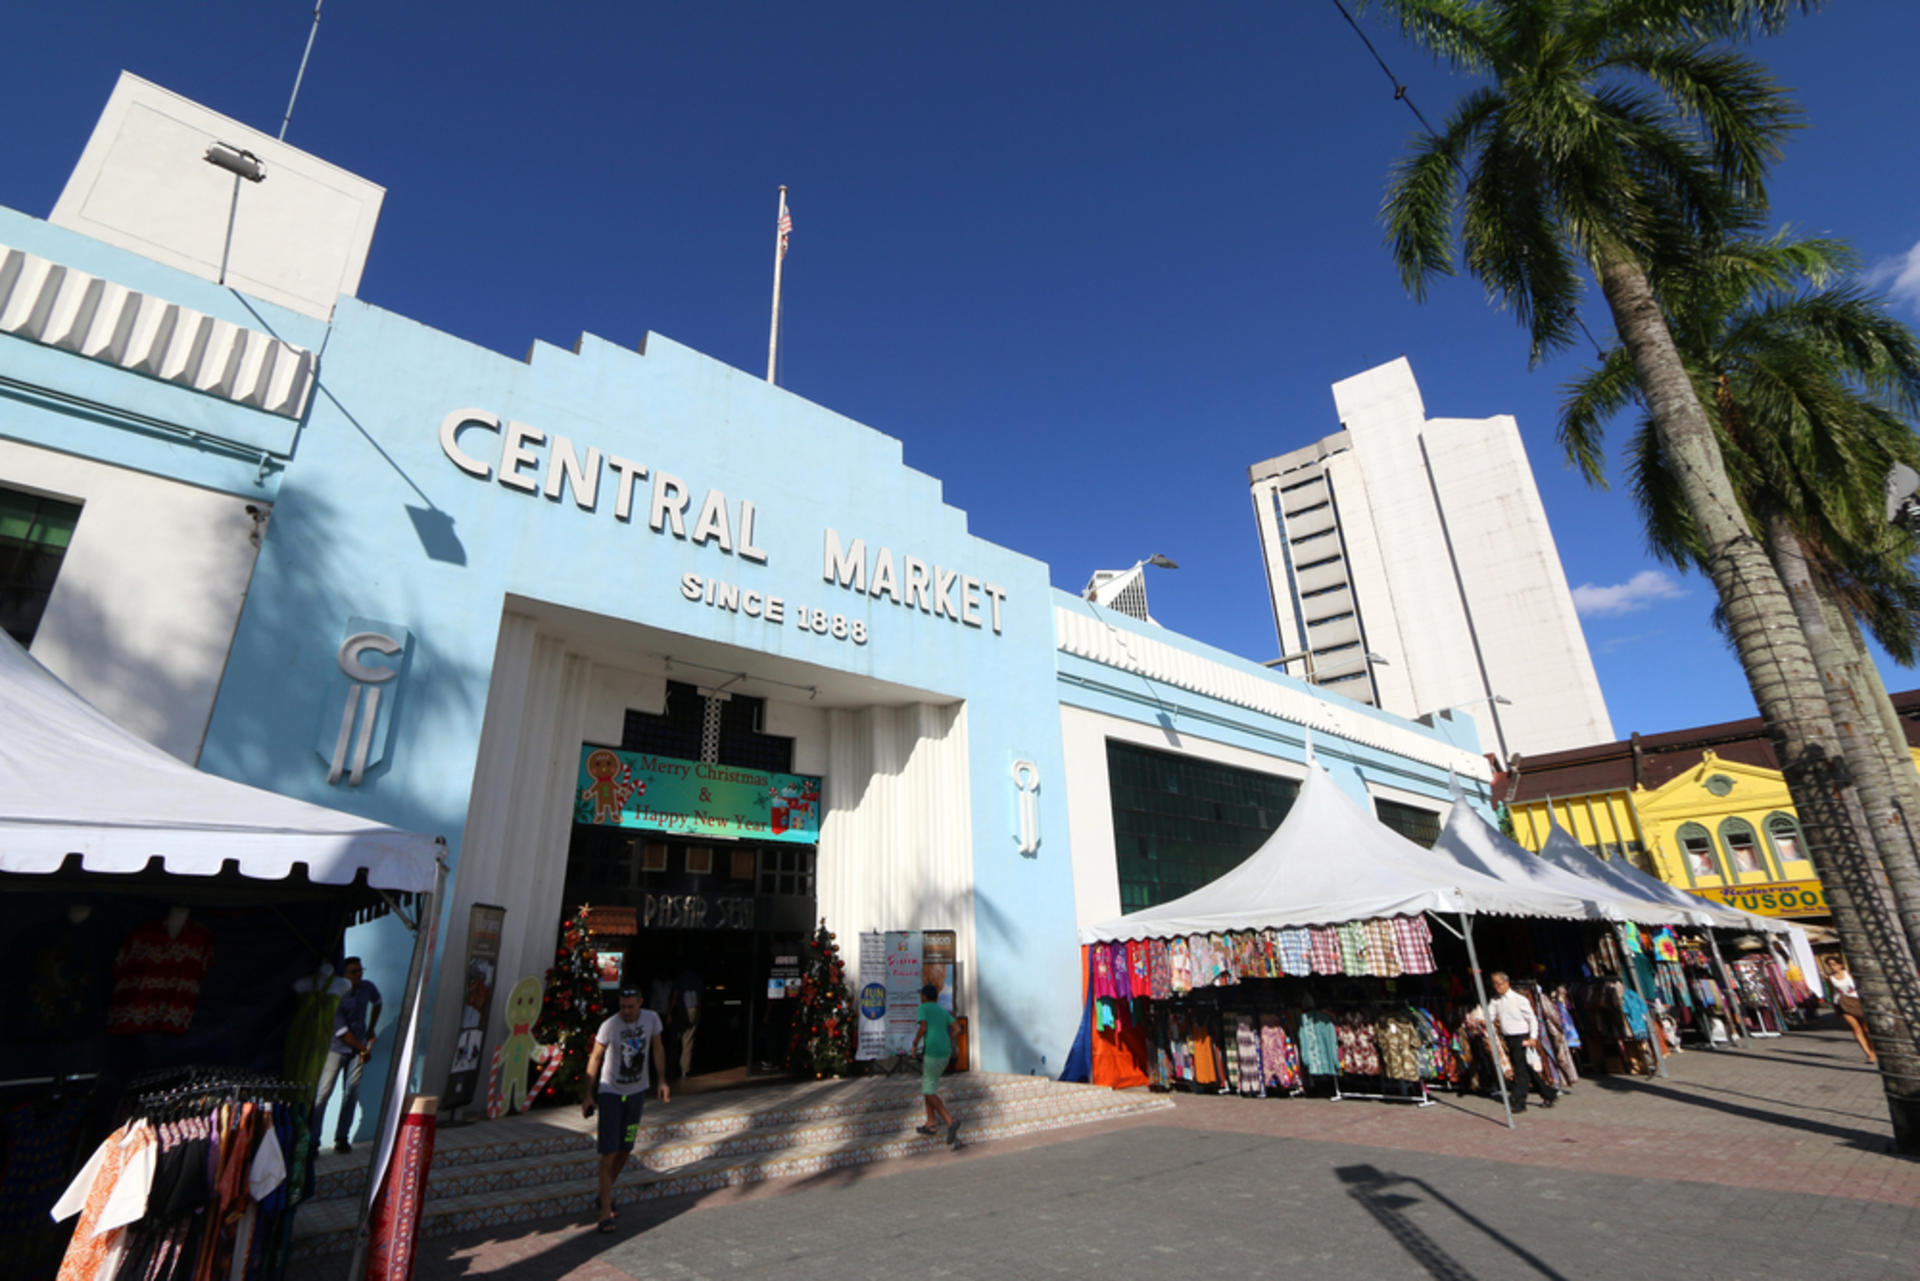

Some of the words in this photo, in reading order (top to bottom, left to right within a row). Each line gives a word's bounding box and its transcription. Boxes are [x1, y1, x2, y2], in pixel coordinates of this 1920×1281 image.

[439, 408, 768, 565] CENTRAL
[823, 528, 1007, 634] MARKET
[680, 572, 784, 624] SINCE
[798, 605, 869, 645] 1888
[640, 756, 692, 780] Merry
[695, 764, 769, 787] Christmas
[699, 787, 712, 803] &
[635, 804, 690, 828] Happy
[694, 810, 730, 829] New
[735, 814, 768, 833] Year
[643, 893, 709, 928] PASAR
[1722, 890, 1827, 910] YUSOO
